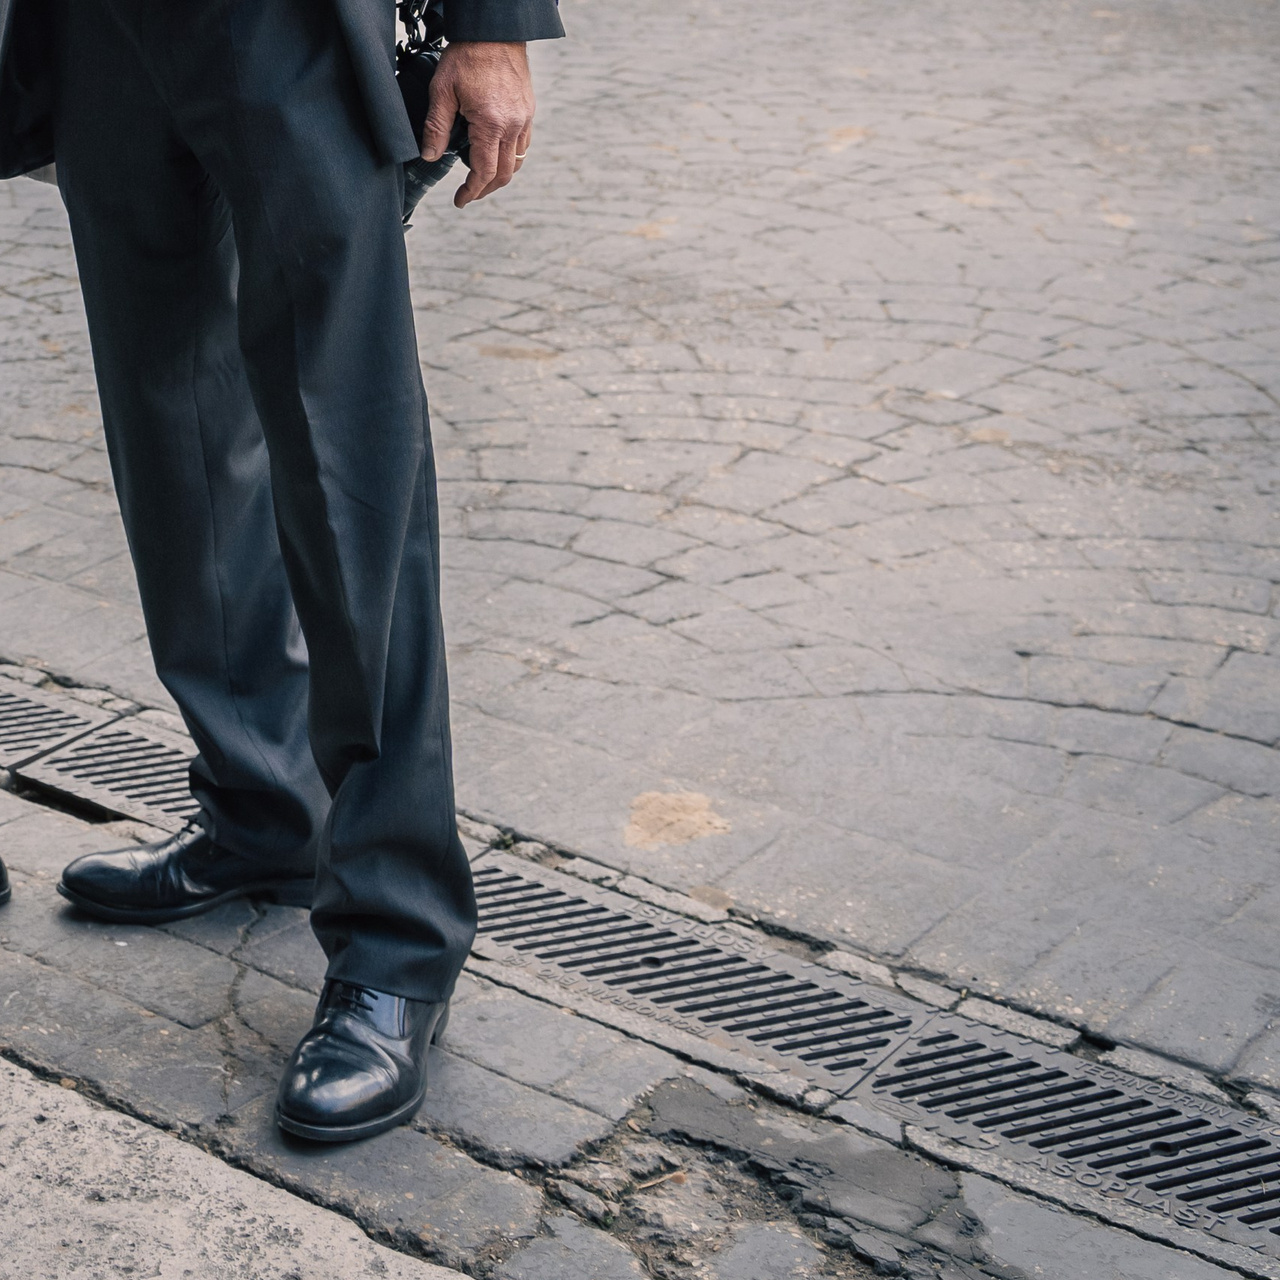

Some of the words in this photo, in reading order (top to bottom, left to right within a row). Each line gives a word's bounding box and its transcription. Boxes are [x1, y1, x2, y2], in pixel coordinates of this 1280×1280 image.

[622, 901, 778, 961] ASOPLAST
[1074, 1060, 1234, 1119] TECHNODRAIN
[1023, 1155, 1227, 1232] ASOPLAST
